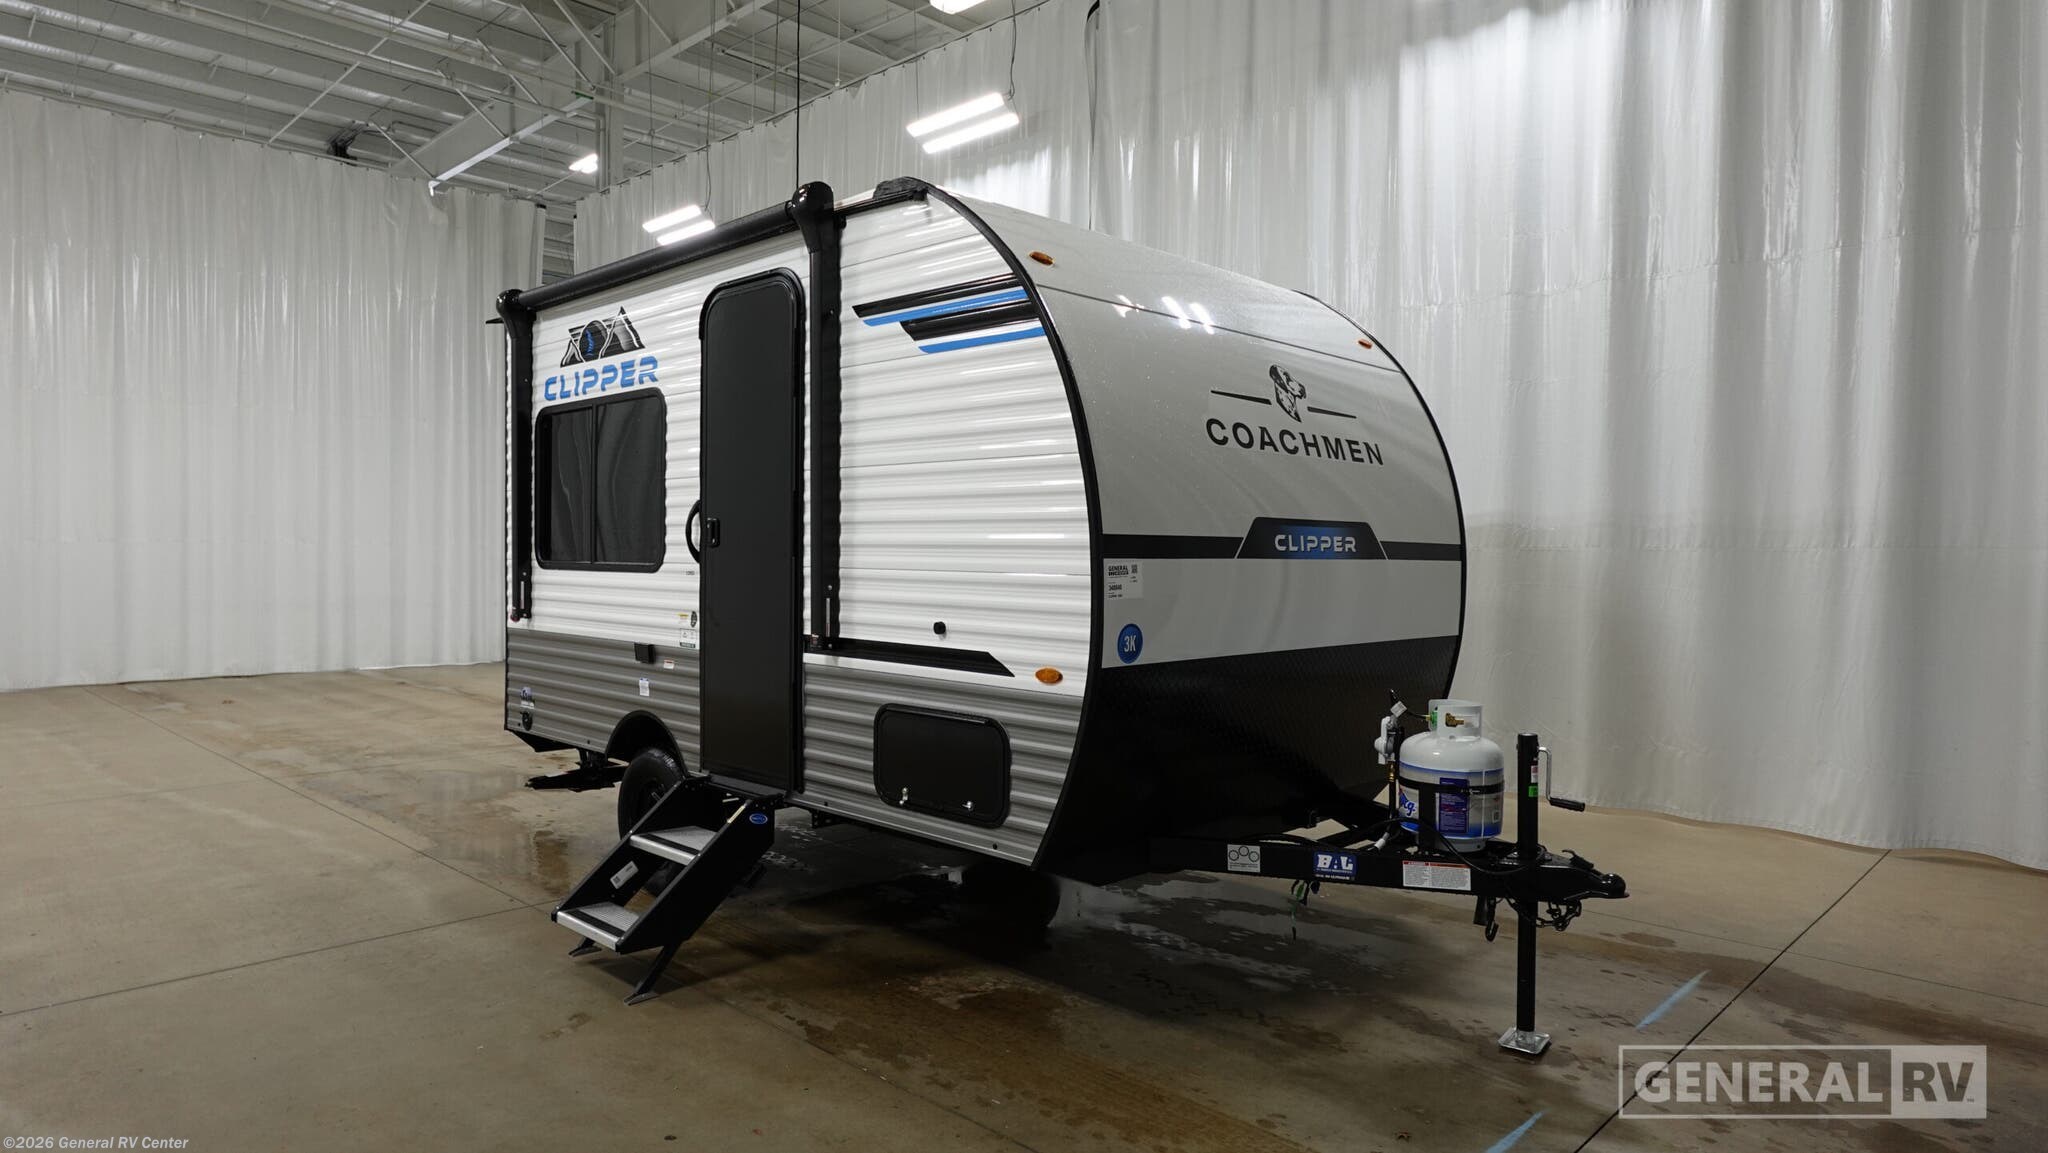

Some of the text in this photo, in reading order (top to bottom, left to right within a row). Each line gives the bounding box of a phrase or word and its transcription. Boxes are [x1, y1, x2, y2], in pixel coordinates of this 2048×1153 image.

[544, 355, 658, 401] CLIPPER
[1206, 418, 1384, 466] COACHMEN
[1274, 534, 1357, 553] CLIPPER
[1124, 634, 1137, 652] 3K
[1317, 854, 1354, 871] BAL
